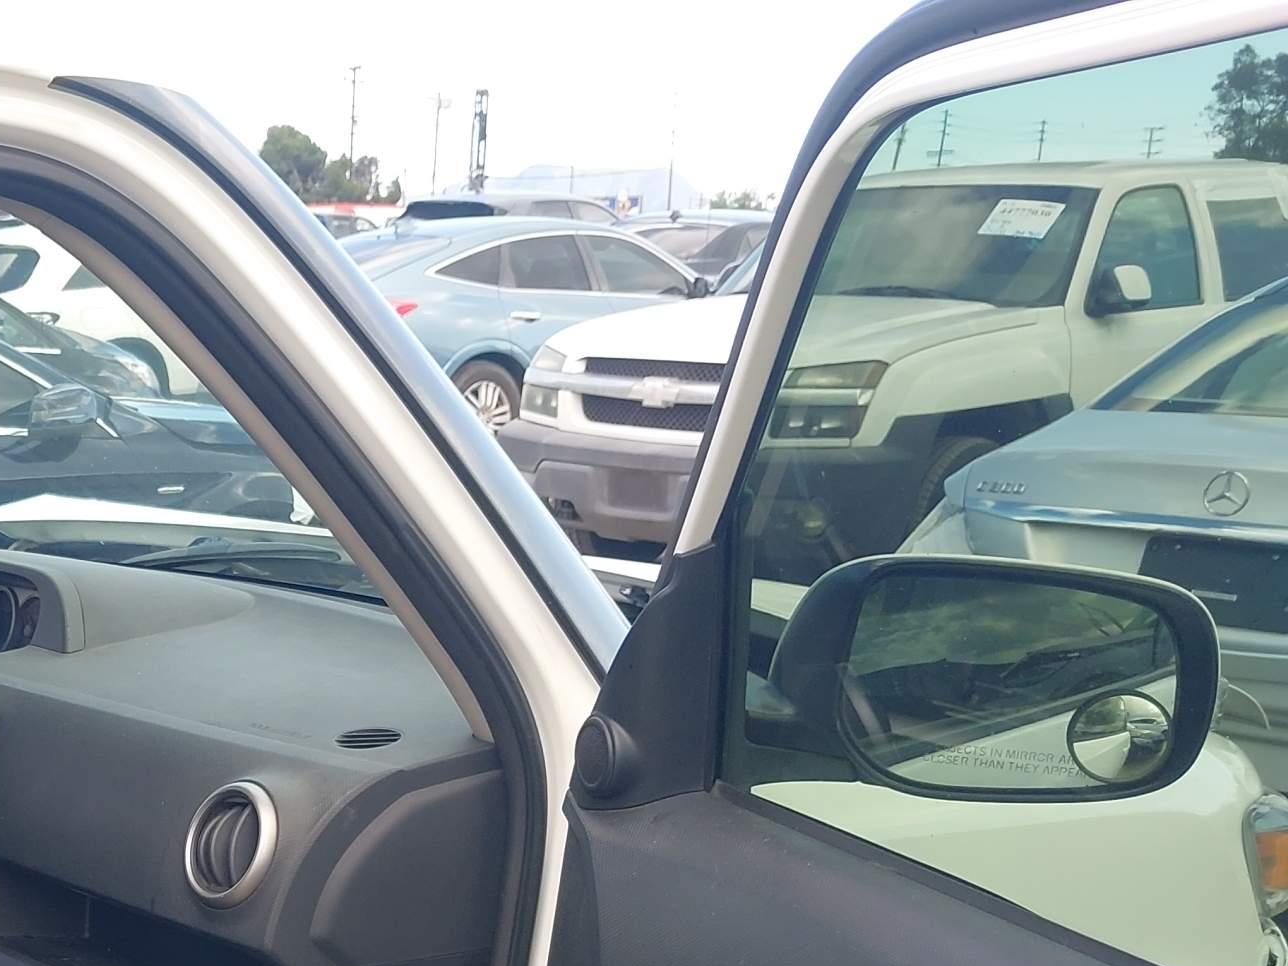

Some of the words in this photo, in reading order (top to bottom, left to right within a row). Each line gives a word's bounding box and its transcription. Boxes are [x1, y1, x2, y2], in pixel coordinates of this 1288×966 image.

[990, 746, 1003, 758] IN
[1006, 749, 1055, 764] MIRROR
[973, 756, 1005, 770] THAN
[1008, 760, 1040, 774] THEY
